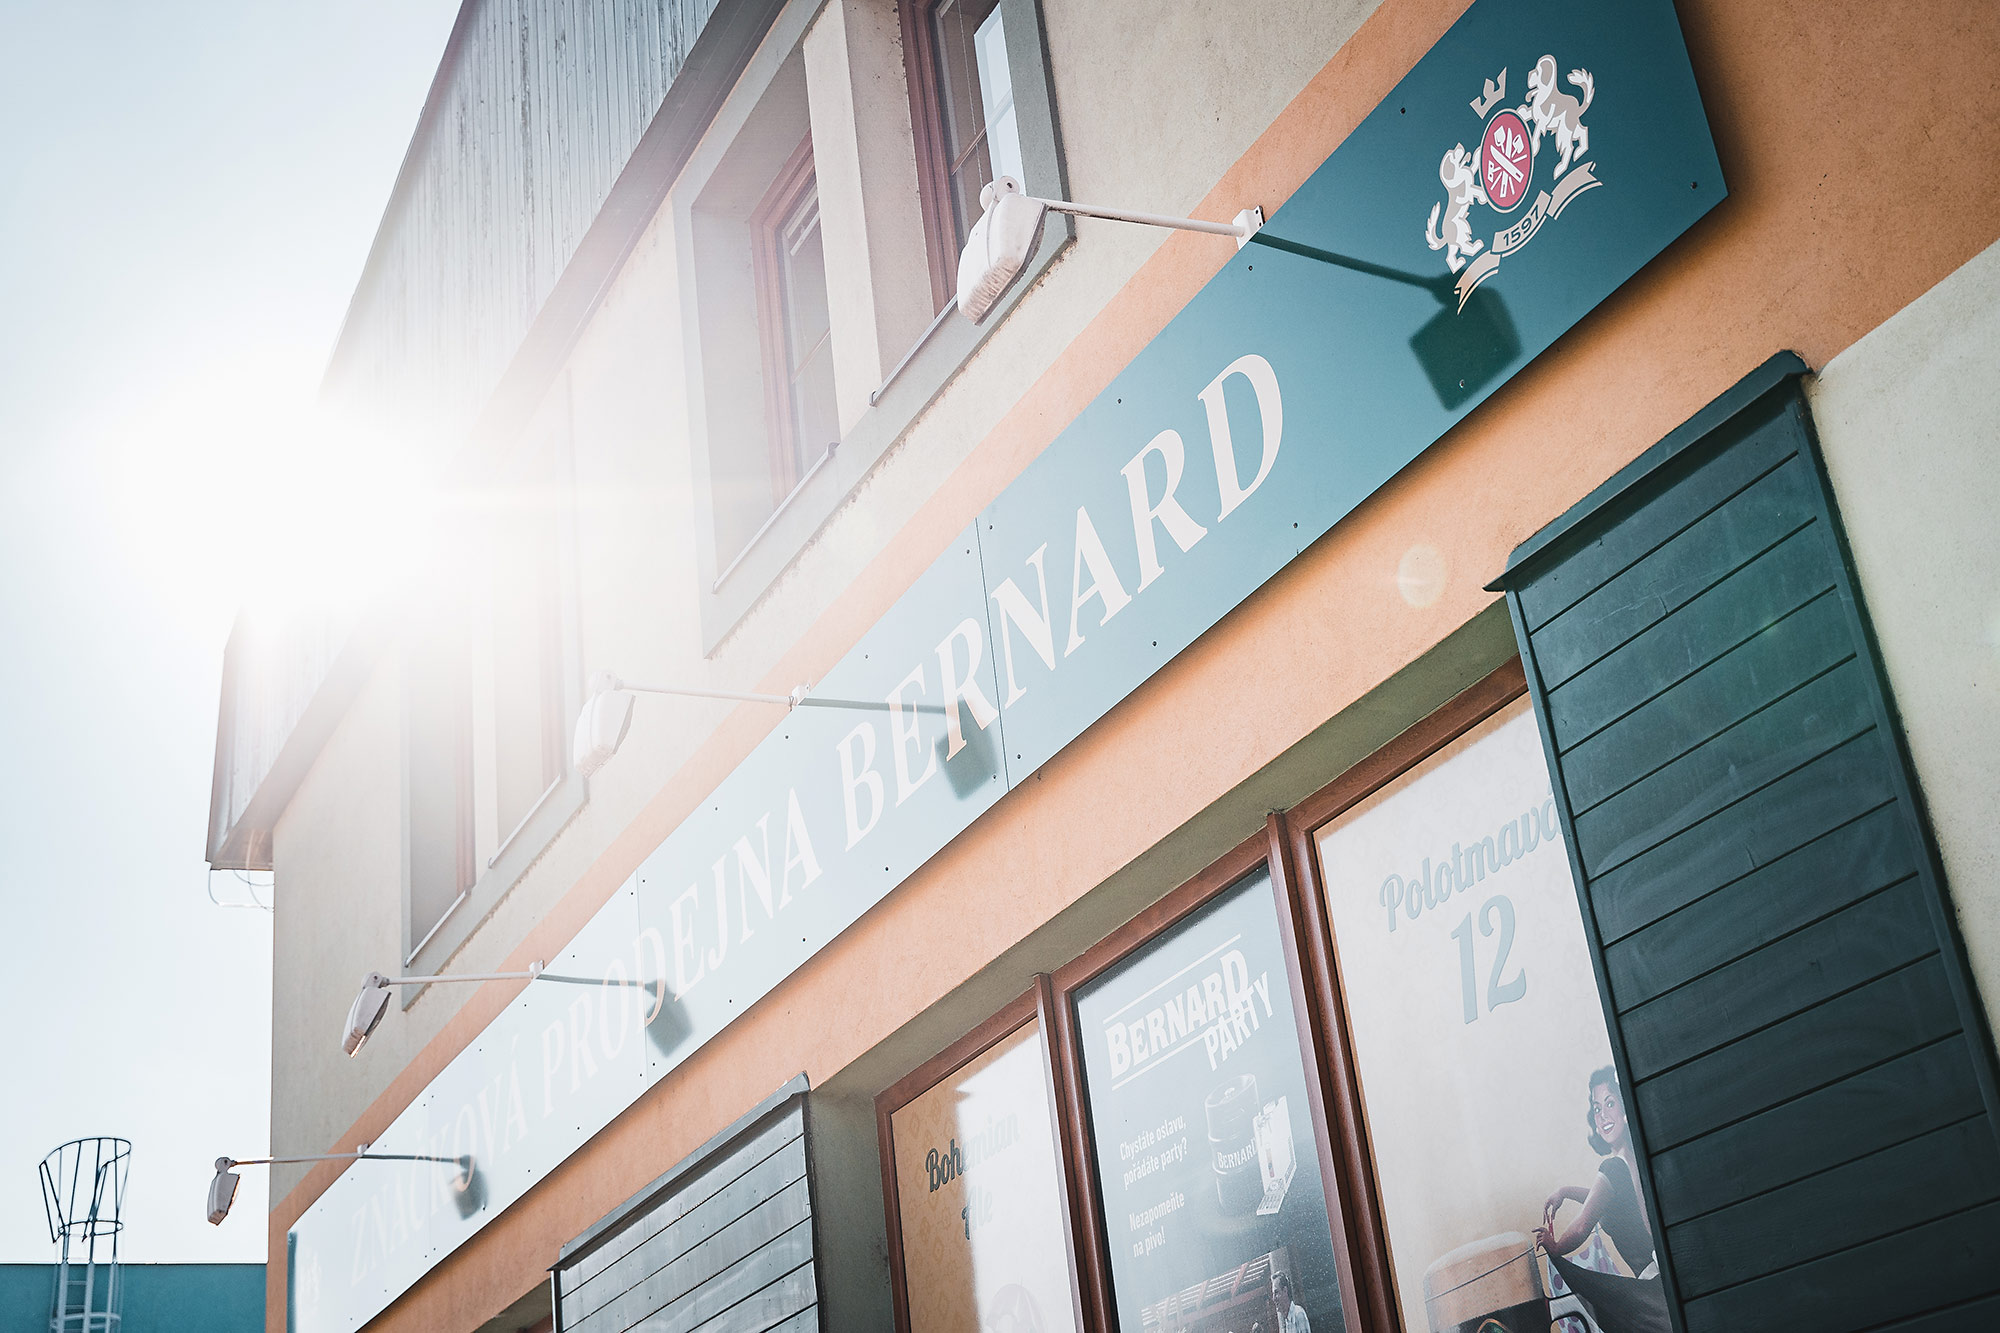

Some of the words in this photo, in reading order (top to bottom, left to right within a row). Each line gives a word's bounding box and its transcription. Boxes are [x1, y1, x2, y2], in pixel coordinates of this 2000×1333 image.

[1503, 204, 1540, 247] 1597
[350, 1036, 530, 1288] ZNAČKOVÁ
[541, 787, 823, 1119] PRODEJNA
[836, 354, 1283, 852] BERNARD
[1451, 894, 1527, 1024] 12
[1105, 949, 1251, 1080] BERNARD
[1202, 971, 1274, 1071] PARTY
[925, 1112, 1020, 1193] Bohemian
[1119, 1127, 1155, 1161] Chystáte
[1156, 1115, 1187, 1140] oslavu,
[1123, 1155, 1160, 1191] pořádáte
[1161, 1137, 1188, 1171] party?
[961, 1186, 993, 1240] Ale
[1129, 1190, 1185, 1232] Nezapomeňte
[1133, 1239, 1144, 1257] na
[1145, 1226, 1166, 1256] pivo!
